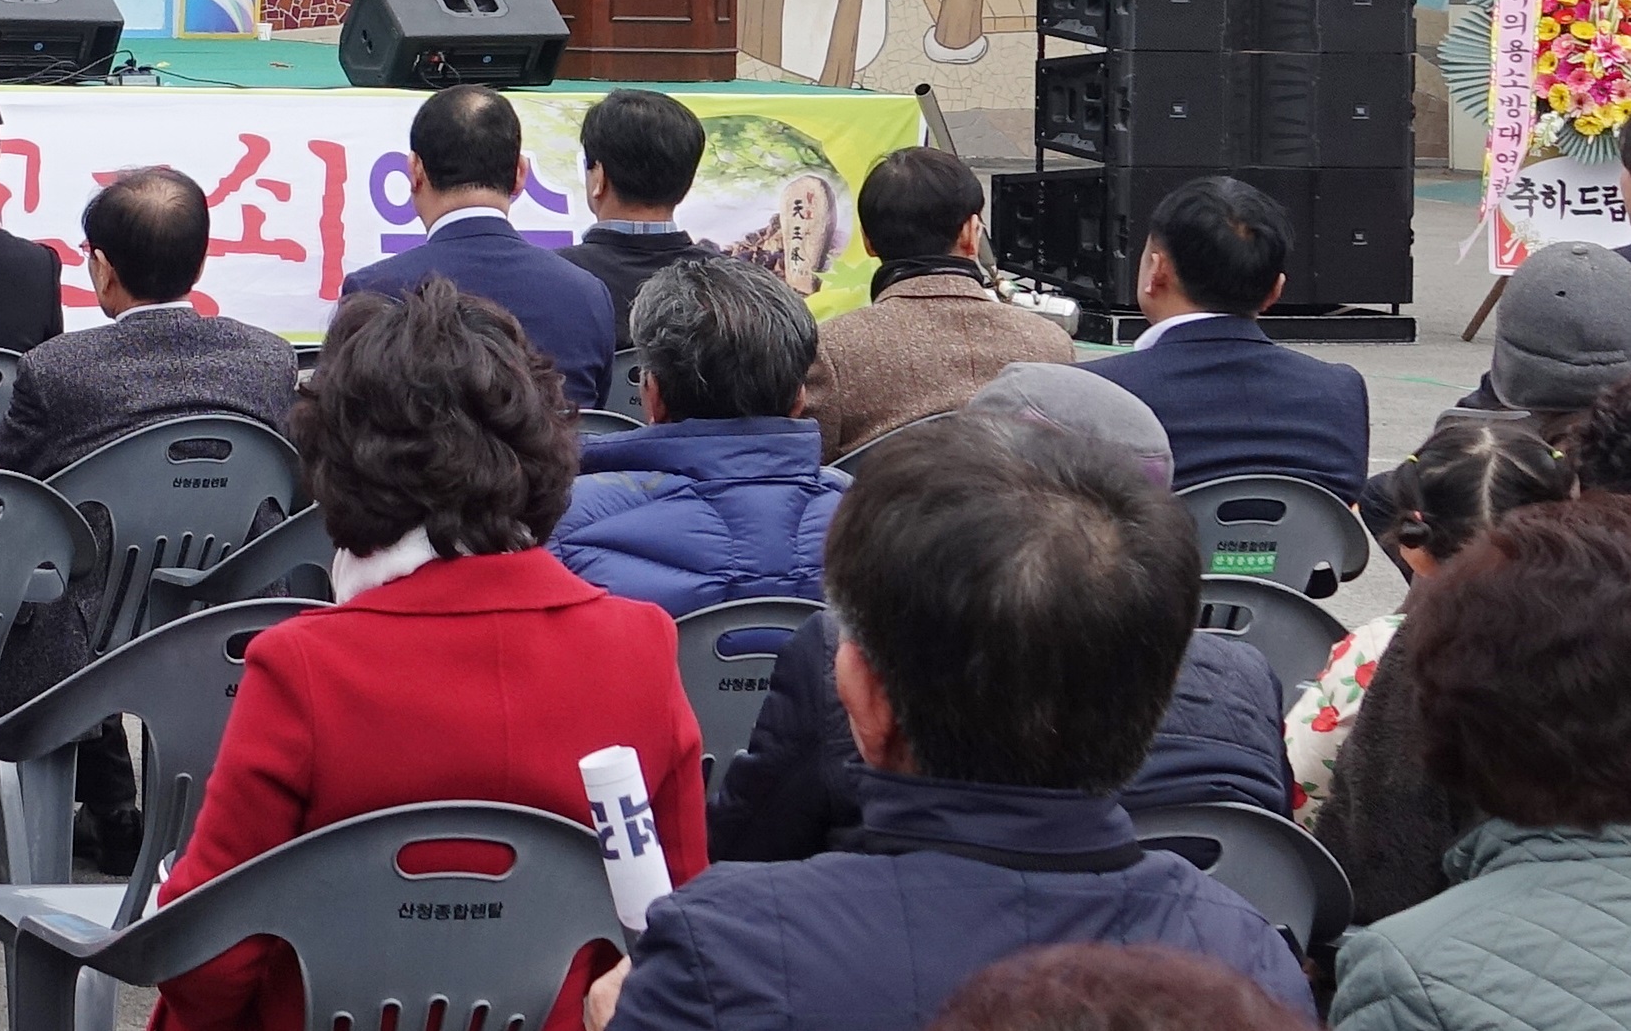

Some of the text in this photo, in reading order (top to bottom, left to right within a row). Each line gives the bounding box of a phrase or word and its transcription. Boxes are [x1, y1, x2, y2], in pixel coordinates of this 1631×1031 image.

[172, 476, 229, 489] 산청종합렌탈
[718, 677, 770, 692] 산청종합
[397, 901, 504, 920] 산청종합렌탈
